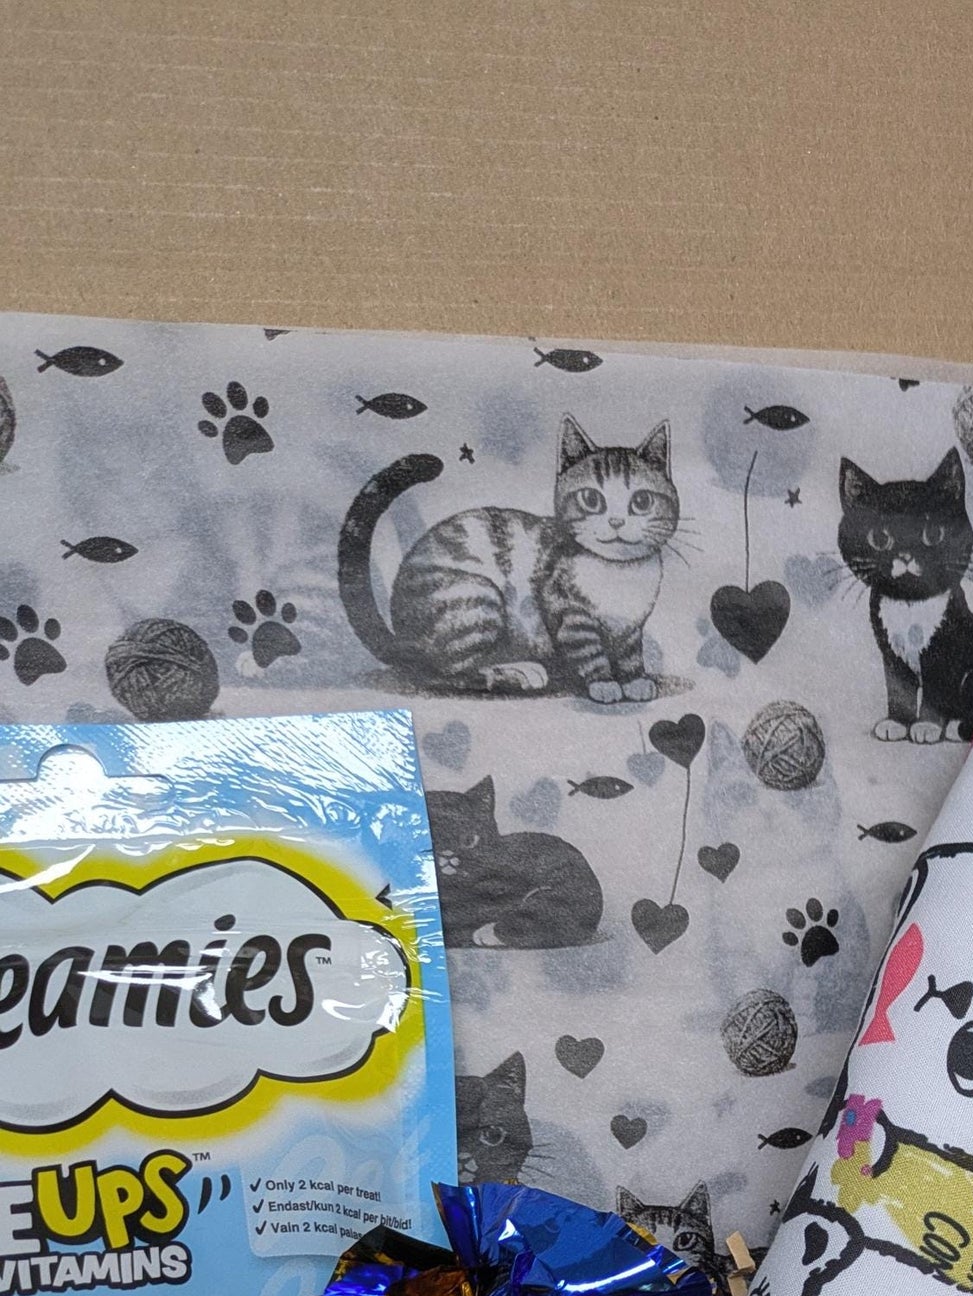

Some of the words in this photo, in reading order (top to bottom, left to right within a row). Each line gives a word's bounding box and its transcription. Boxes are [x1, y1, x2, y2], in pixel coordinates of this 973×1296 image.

[265, 1179, 295, 1192] Only
[298, 1179, 307, 1190] 2
[309, 1179, 335, 1191] kcal
[337, 1184, 354, 1196] per
[356, 1187, 381, 1202] treat!
[268, 1200, 335, 1213] Endast/kun
[335, 1203, 342, 1213] 2
[342, 1204, 361, 1219] kcal
[363, 1211, 379, 1225] per
[270, 1222, 299, 1234] Vain
[302, 1222, 311, 1233] 2
[313, 1222, 338, 1235] kcal
